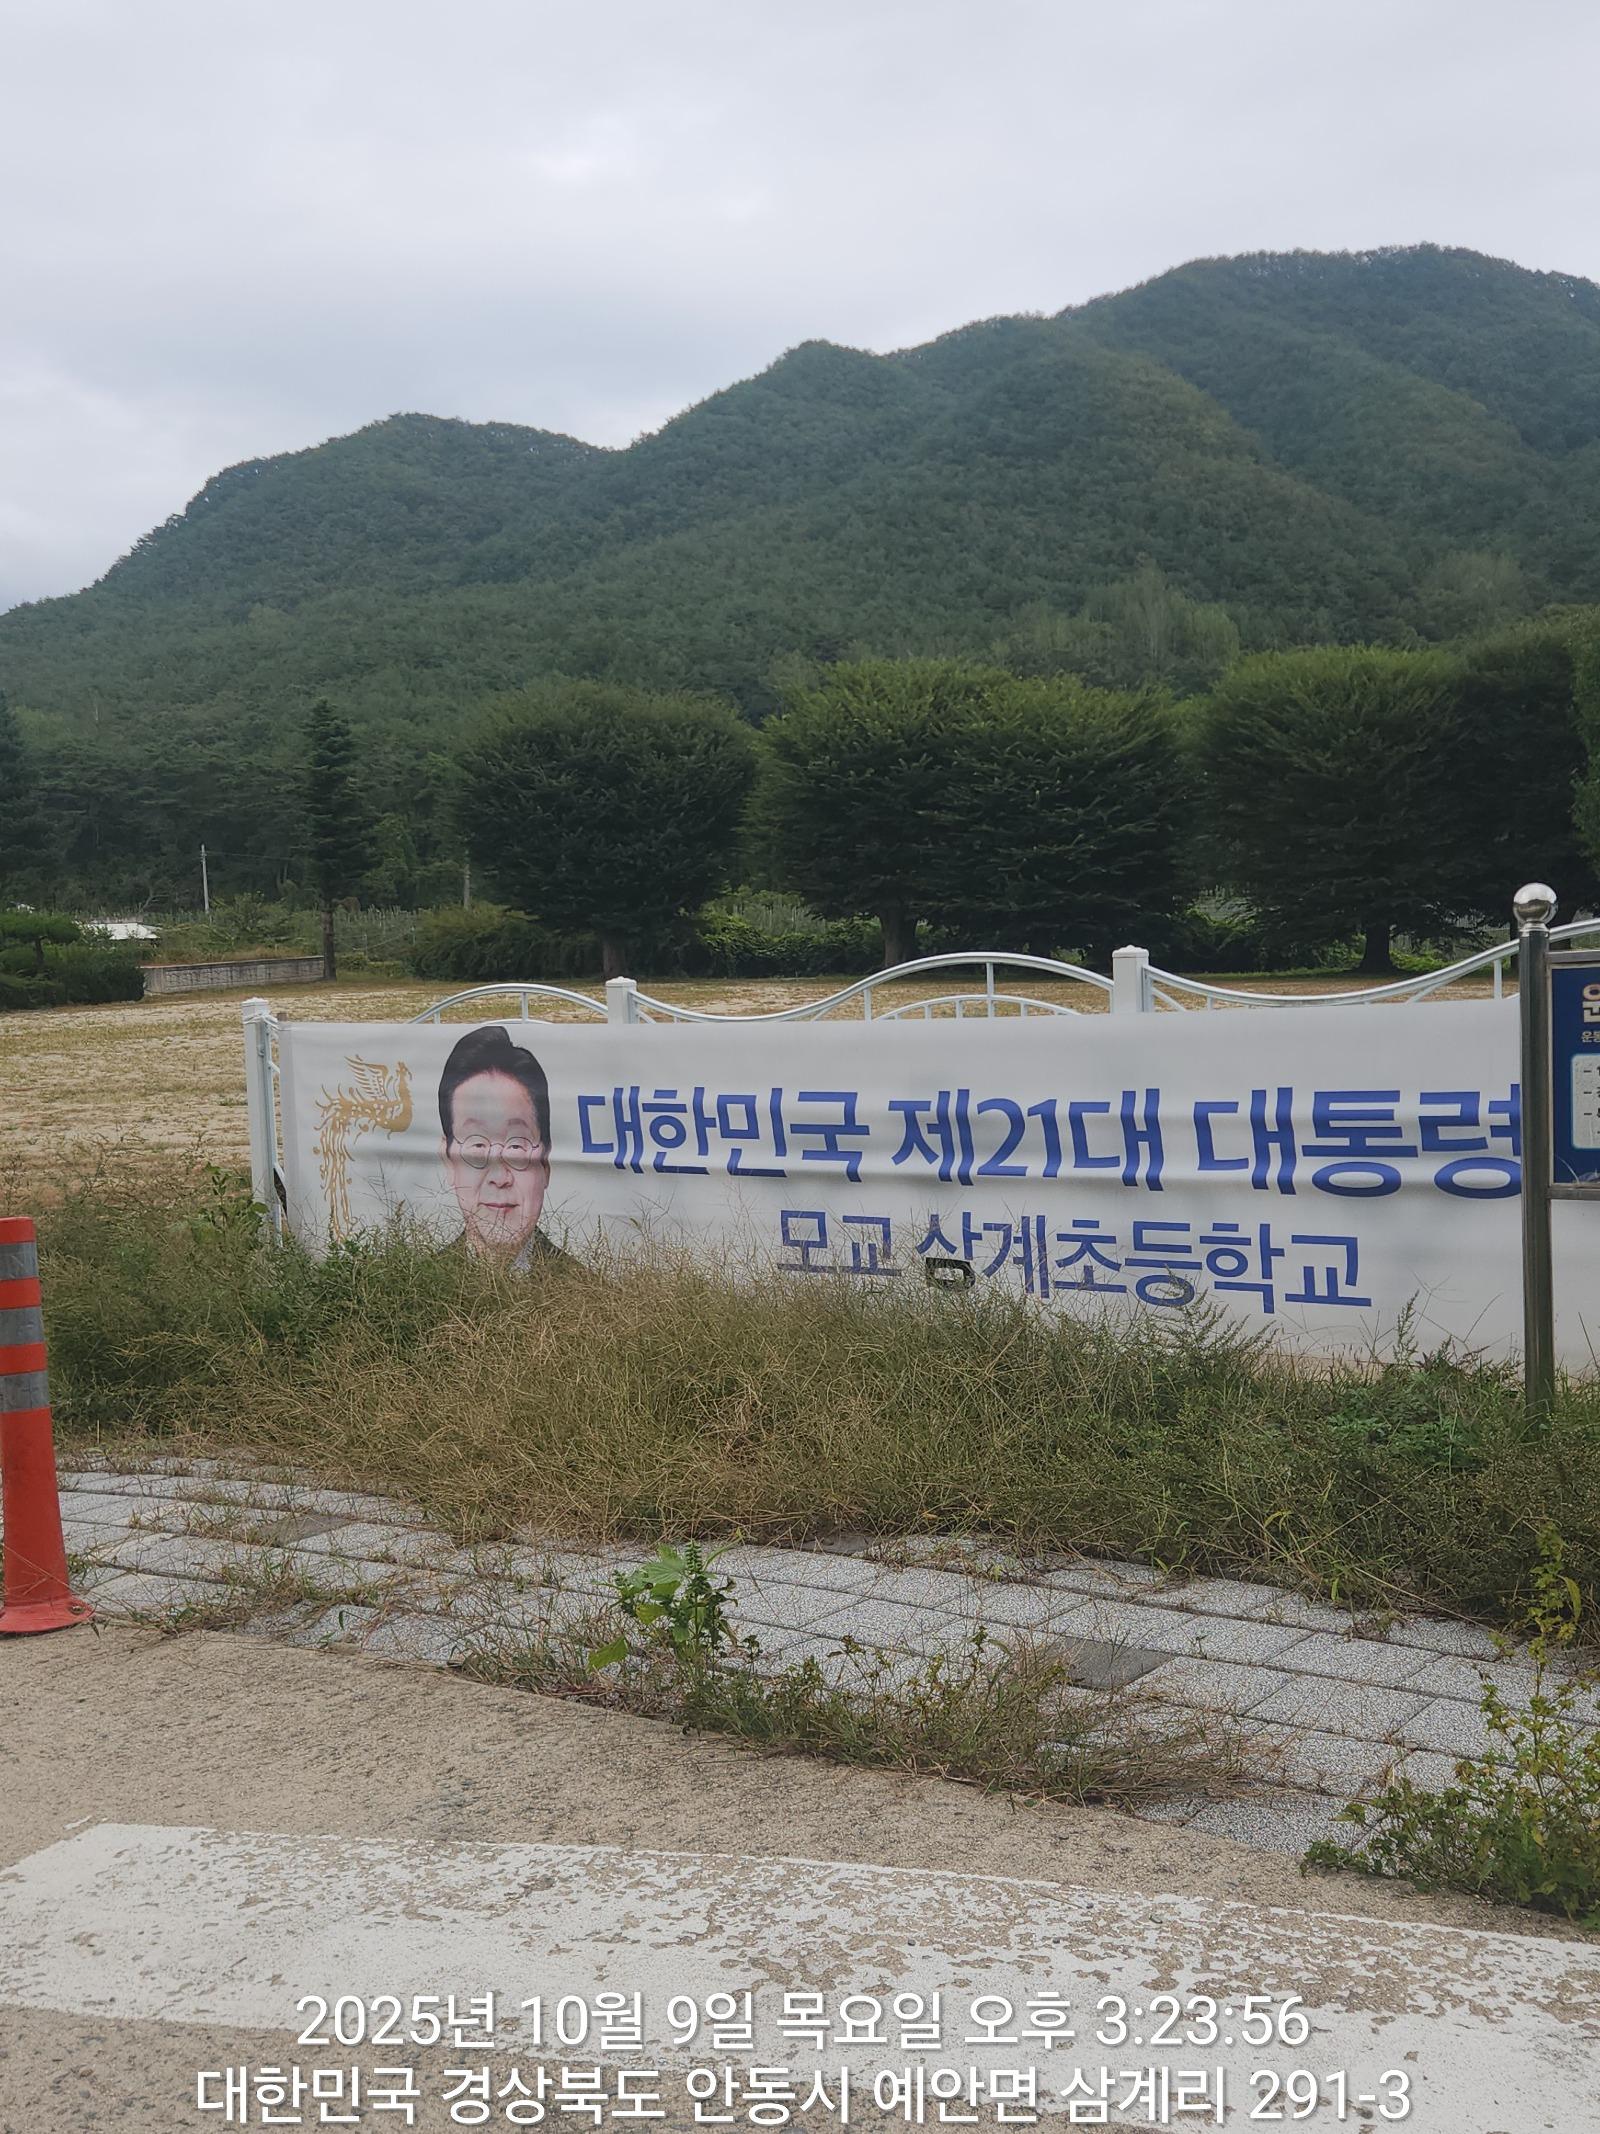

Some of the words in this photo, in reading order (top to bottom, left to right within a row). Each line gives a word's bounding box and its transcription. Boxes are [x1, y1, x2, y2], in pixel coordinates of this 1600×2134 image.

[577, 1085, 870, 1182] 대한민국
[887, 1087, 1164, 1191] 제21대
[1193, 1083, 1522, 1199] 대통령
[777, 1209, 901, 1276] 모교
